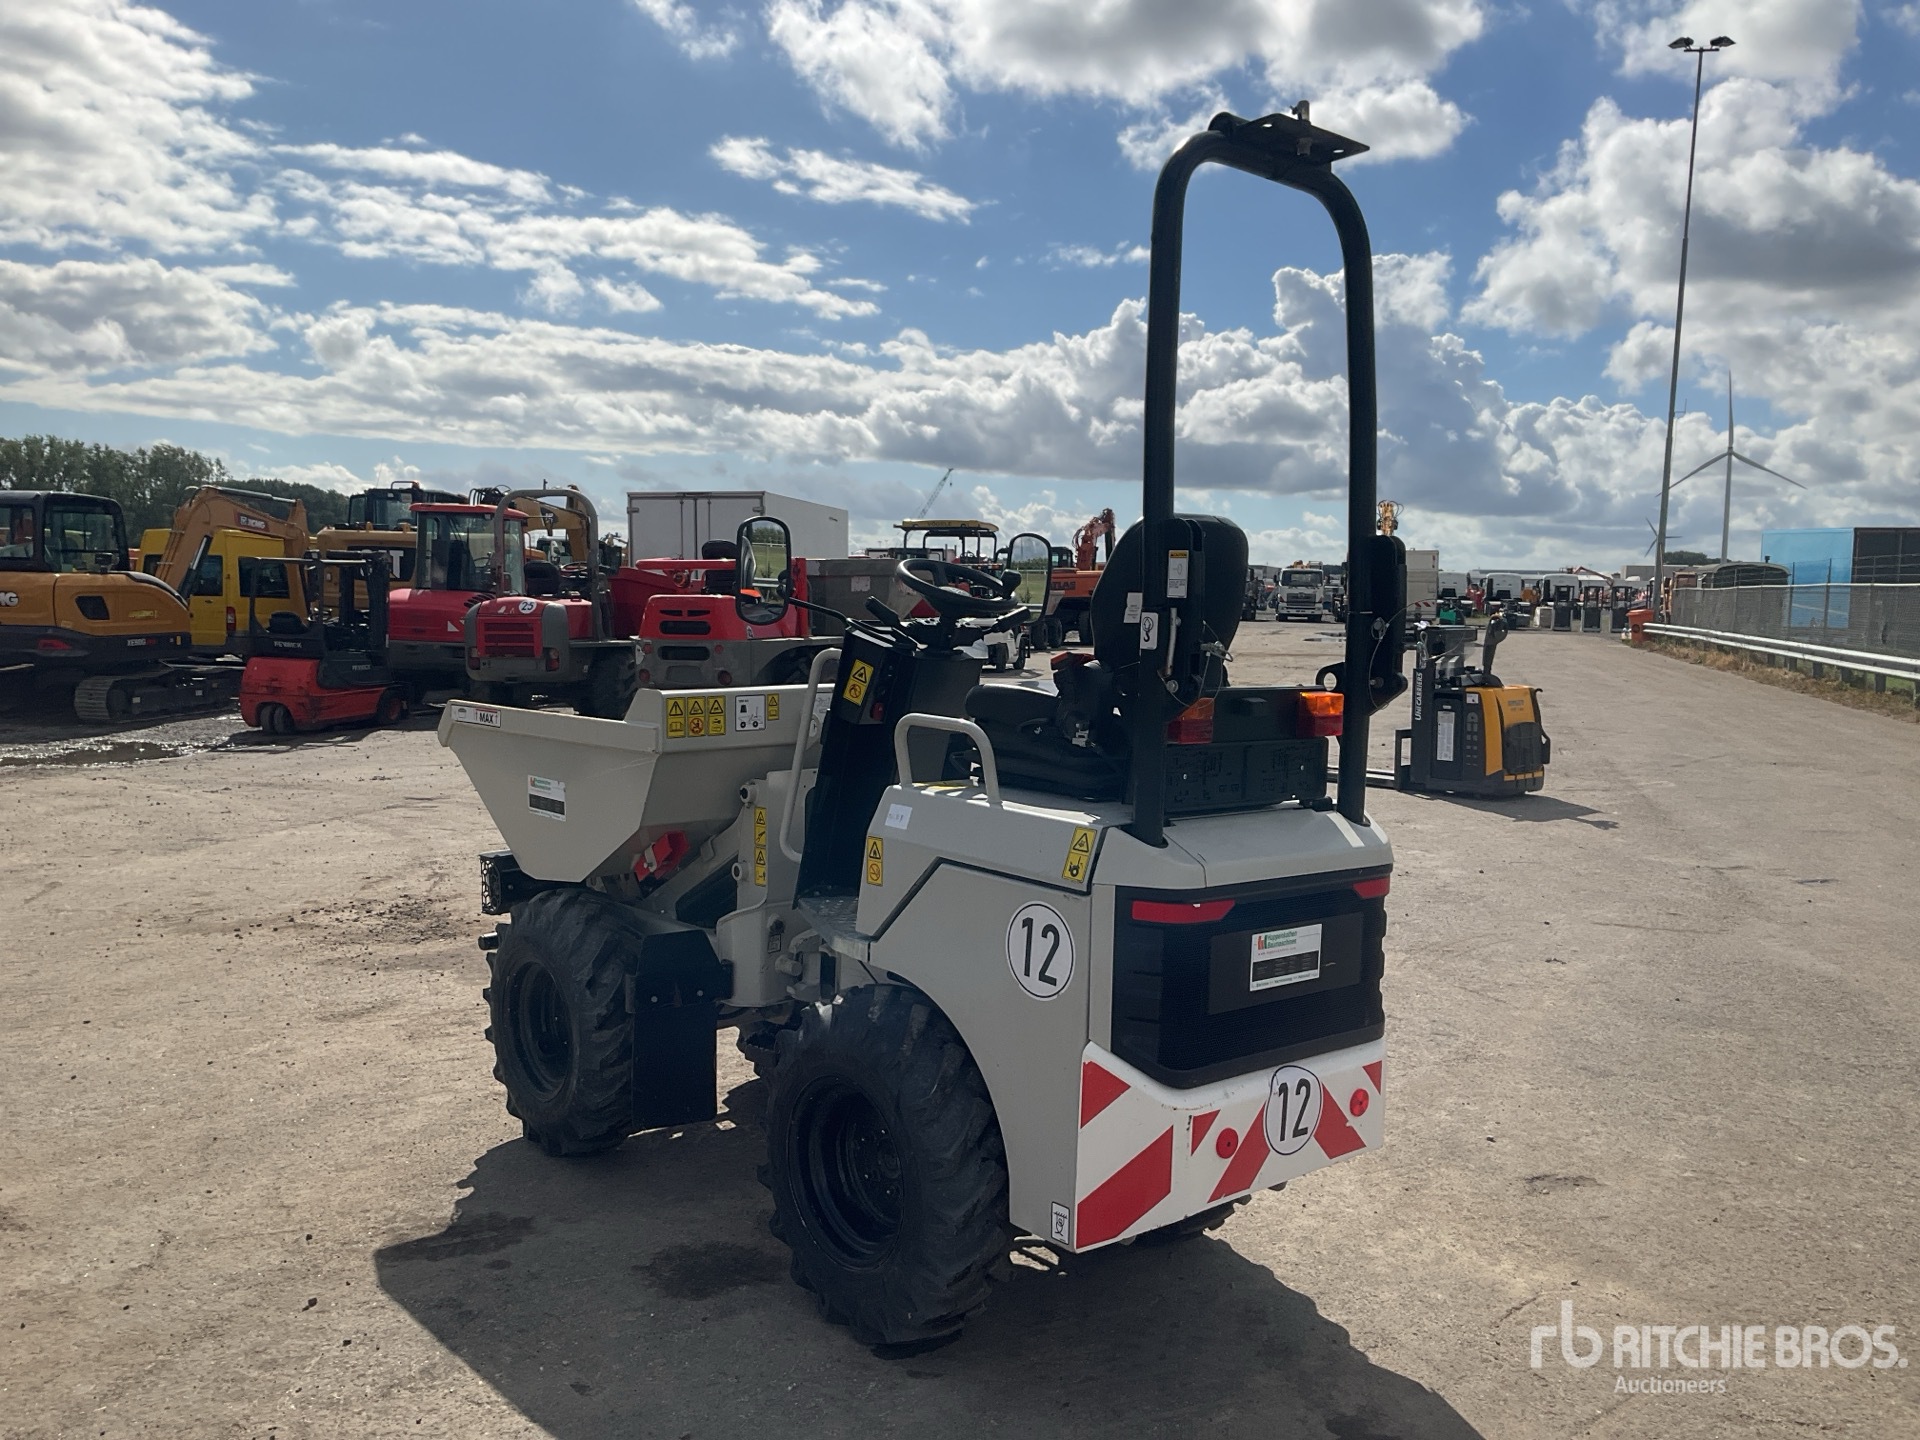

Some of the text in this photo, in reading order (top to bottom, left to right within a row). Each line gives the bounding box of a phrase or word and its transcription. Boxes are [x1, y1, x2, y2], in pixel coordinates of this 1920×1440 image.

[521, 601, 534, 611] 25
[479, 712, 494, 724] MAX
[1414, 672, 1423, 721] UNICARRIERS
[1021, 917, 1060, 987] 12
[1278, 1078, 1311, 1142] 12
